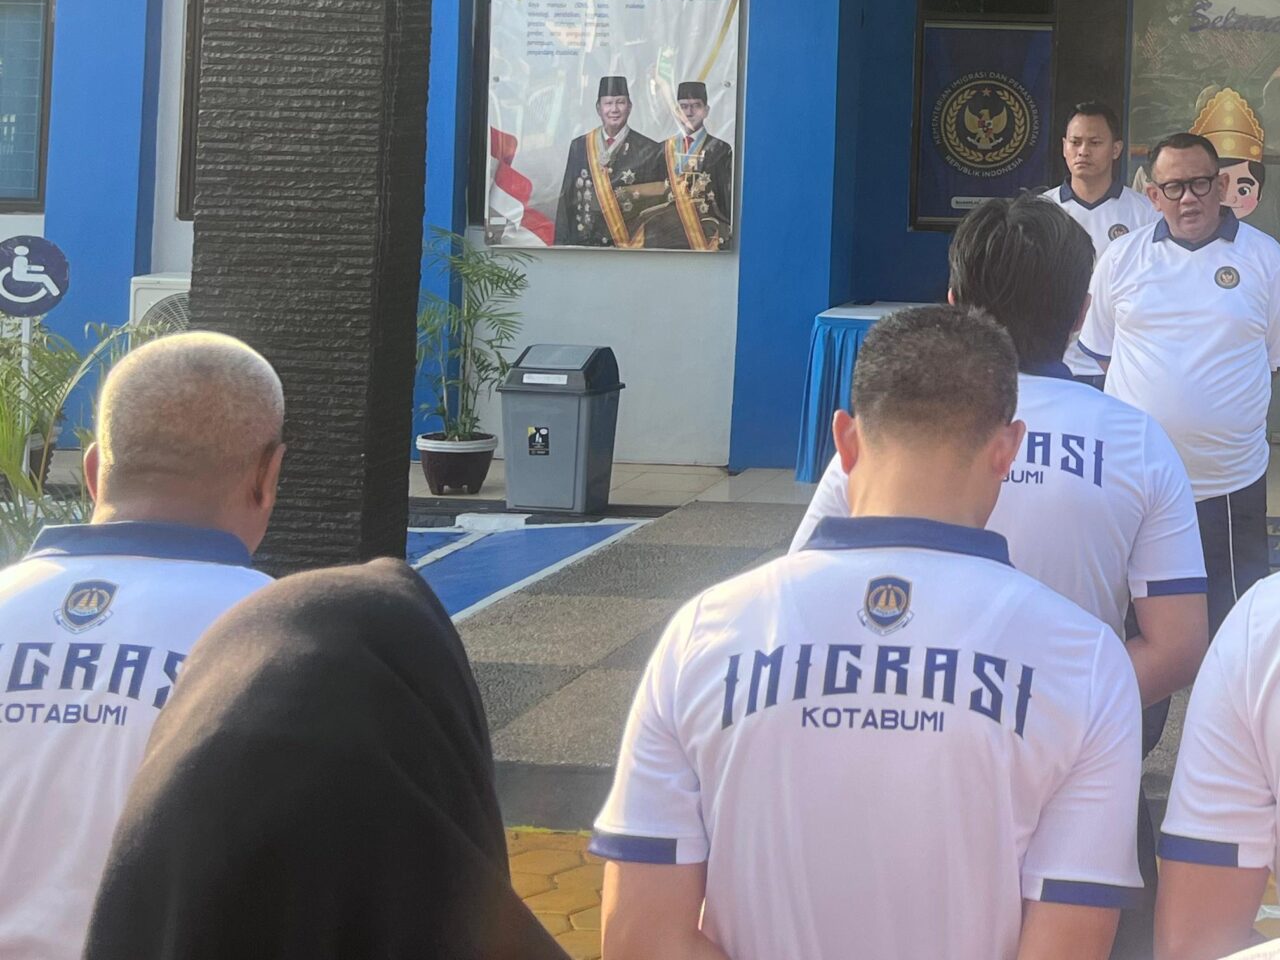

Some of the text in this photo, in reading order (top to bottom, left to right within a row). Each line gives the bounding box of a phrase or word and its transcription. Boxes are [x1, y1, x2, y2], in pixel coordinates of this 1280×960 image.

[952, 72, 987, 88] IMIGRASI
[982, 157, 1024, 177] INDONESIA
[1022, 430, 1105, 488] ASI
[721, 643, 1036, 740] IMIGRASI
[801, 706, 945, 732] KOTABUMI
